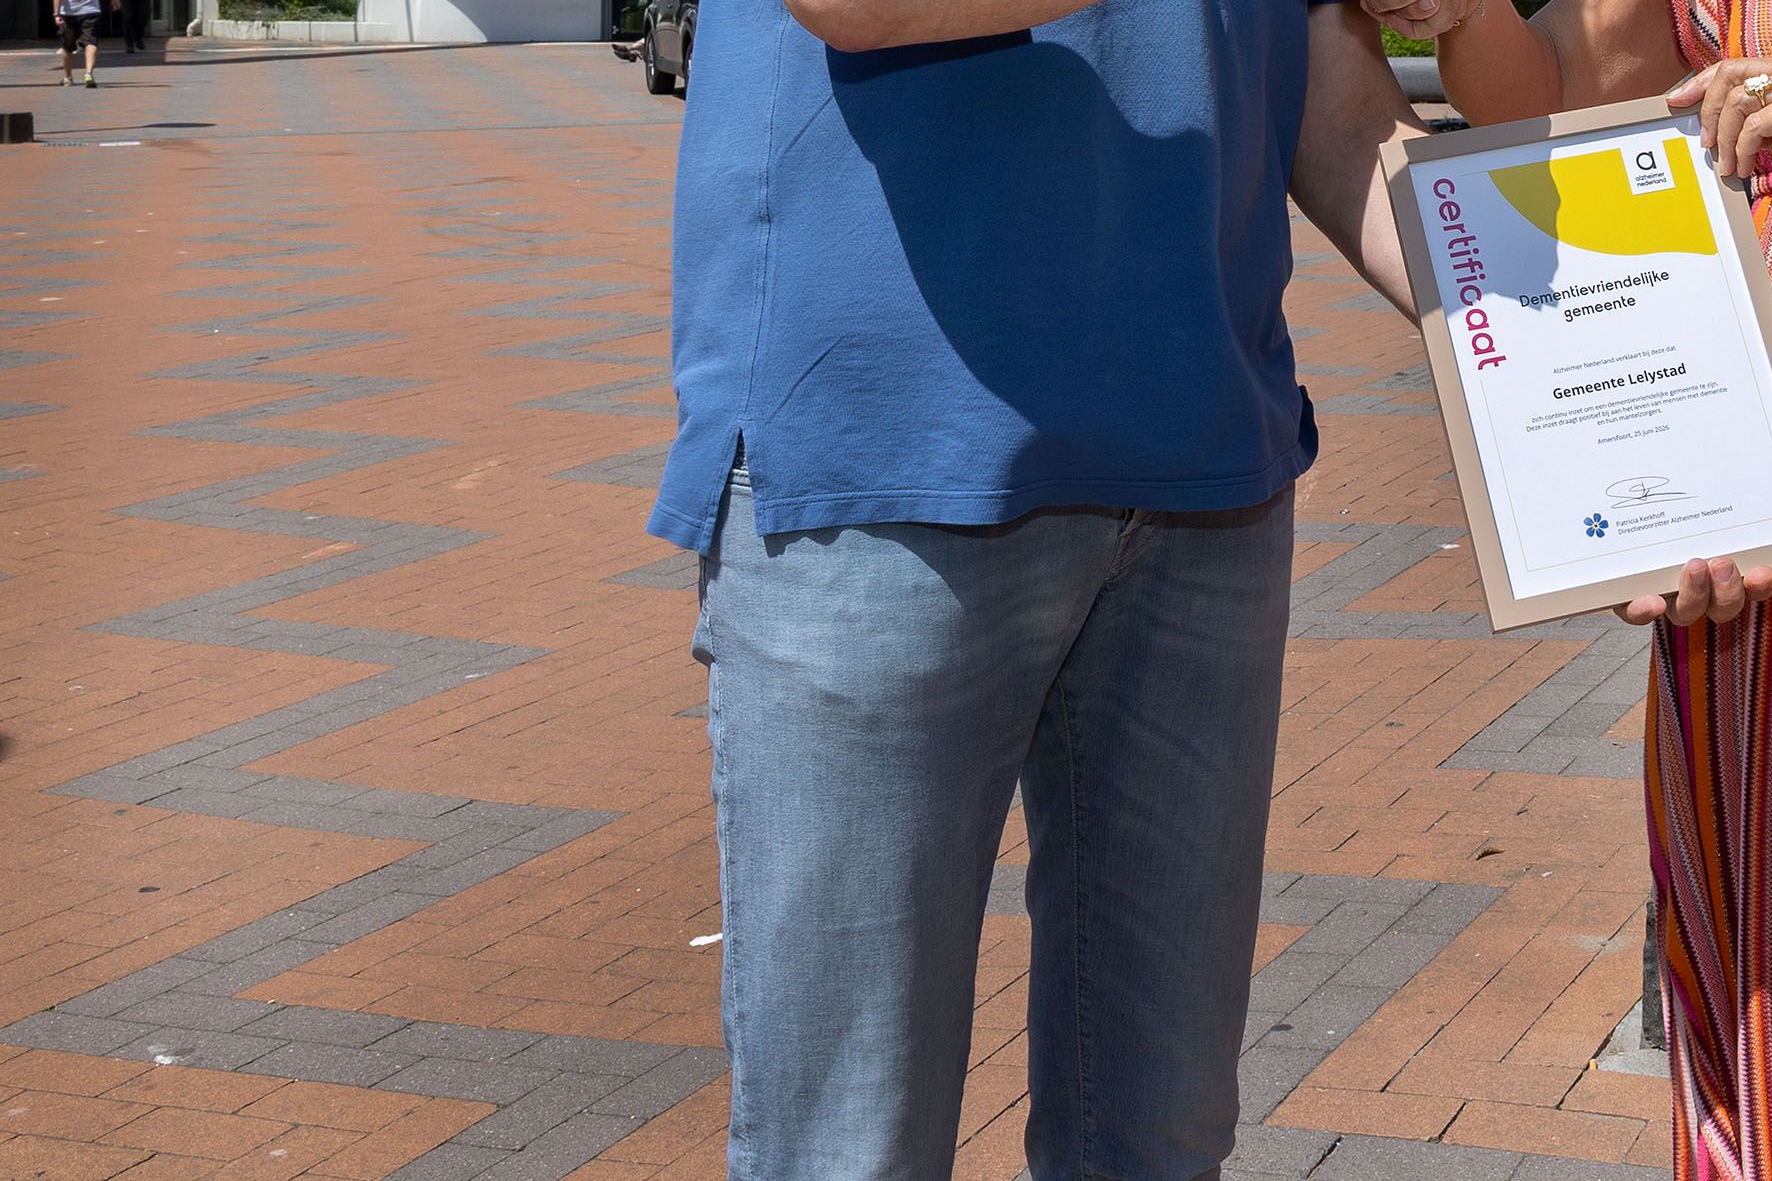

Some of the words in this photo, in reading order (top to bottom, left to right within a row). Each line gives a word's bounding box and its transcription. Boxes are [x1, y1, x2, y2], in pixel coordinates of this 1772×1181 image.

[1636, 151, 1657, 171] a
[1635, 172, 1665, 181] alzheimer
[1636, 177, 1667, 187] nederland
[1432, 177, 1507, 371] certificaat
[1519, 269, 1670, 308] Dementievriendelijke
[1564, 294, 1636, 322] gemeente
[1553, 363, 1582, 374] Alzheimer
[1584, 357, 1615, 368] Nederland
[1615, 352, 1641, 361] verklaart
[1642, 350, 1650, 358] bij
[1651, 348, 1665, 356] deze
[1666, 345, 1676, 353] dat
[1553, 377, 1625, 399] Gemeente
[1628, 363, 1687, 384] Lelystad
[1526, 424, 1541, 433] Deze
[1543, 420, 1557, 428] inzet
[1559, 417, 1578, 426] draagt
[1579, 412, 1601, 422] positief
[1602, 410, 1610, 418] bij
[1634, 402, 1650, 411] leven
[1663, 395, 1686, 404] mensen
[1687, 392, 1699, 400] met
[1700, 387, 1728, 397] dementie
[1545, 412, 1567, 421] continu
[1568, 408, 1583, 416] inzet
[1608, 391, 1668, 408] dementievriendelijke
[1670, 385, 1698, 396] gemeente
[1642, 428, 1654, 437] juni
[1616, 518, 1638, 527] Patricia
[1640, 511, 1666, 522] Kerkhoff
[1618, 519, 1670, 535] Directievoorzitter
[1671, 513, 1700, 524] Alzheimer
[1701, 505, 1733, 517] Nederland
